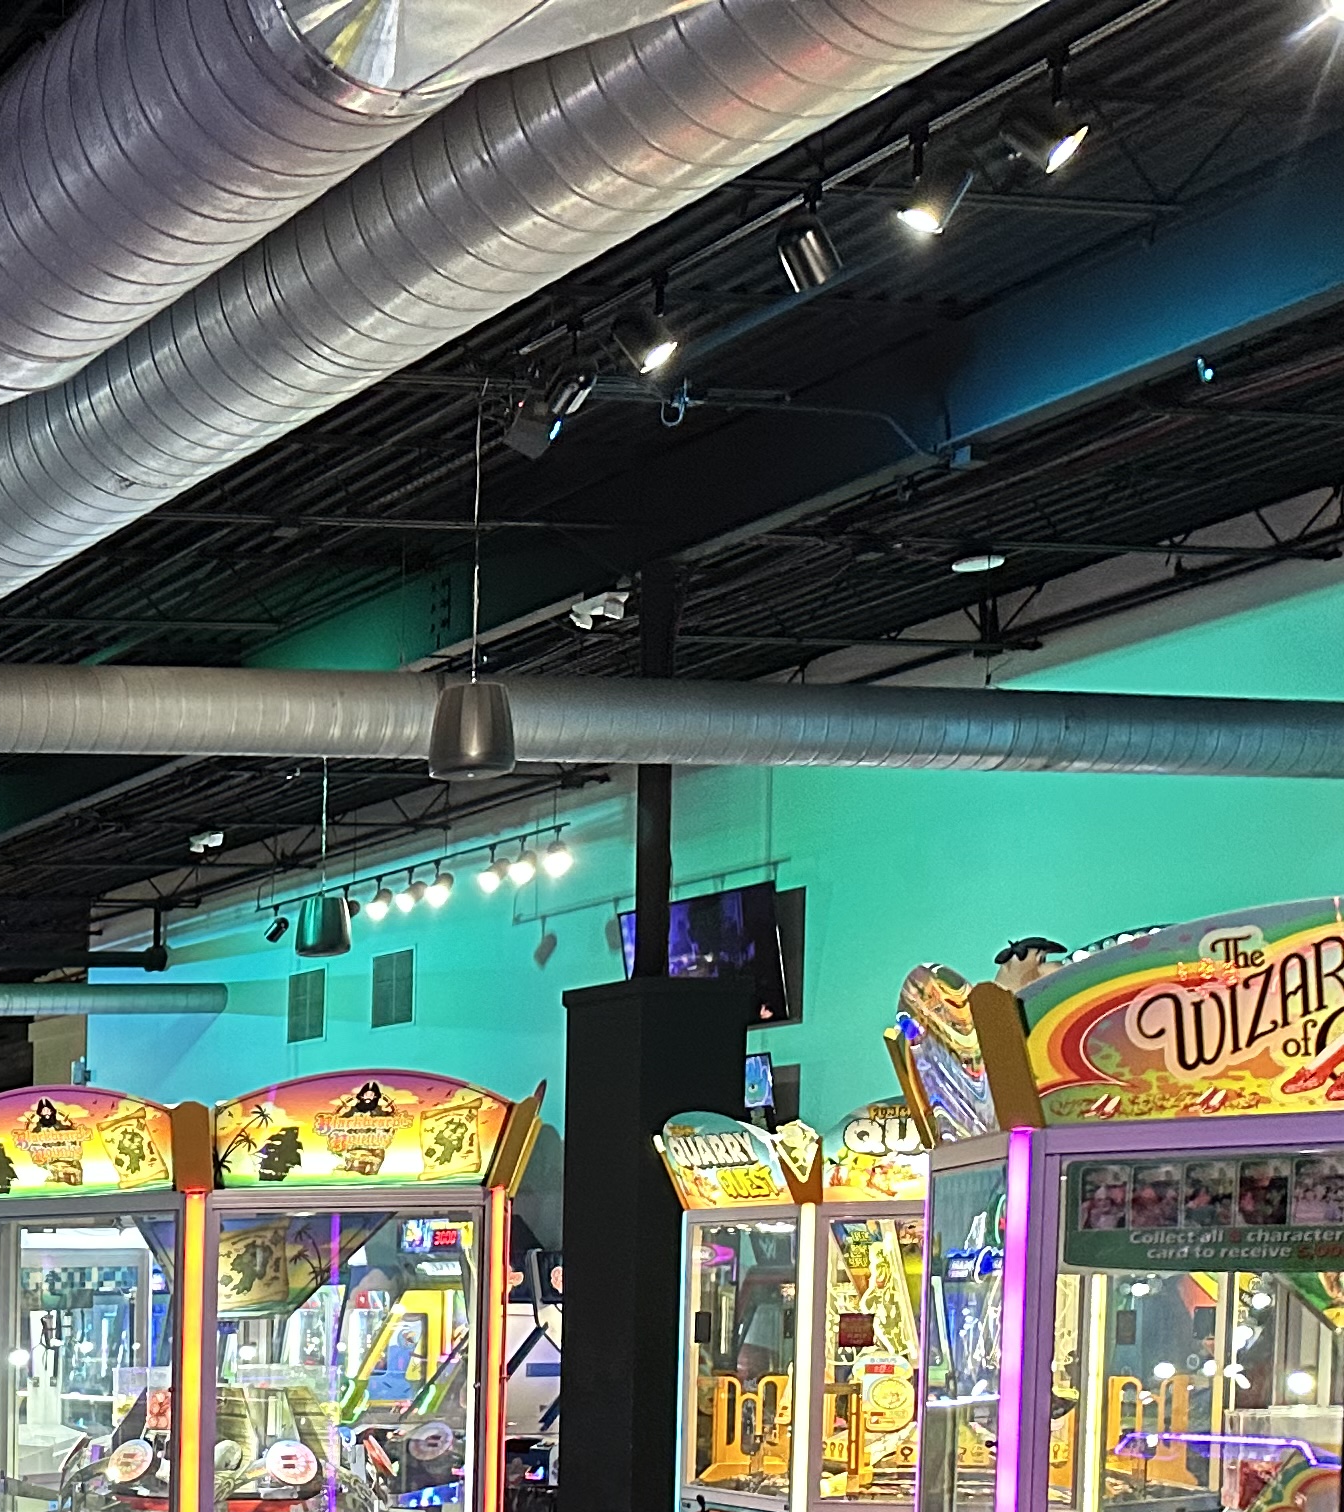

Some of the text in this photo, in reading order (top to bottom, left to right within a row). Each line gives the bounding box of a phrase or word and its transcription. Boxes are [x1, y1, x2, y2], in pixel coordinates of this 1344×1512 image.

[1210, 934, 1266, 968] The
[1282, 1018, 1318, 1058] of
[669, 1131, 760, 1168] QUARRY
[716, 1165, 779, 1198] QUEST
[1129, 1231, 1194, 1245] Collect
[1199, 1229, 1224, 1243] all
[1146, 1245, 1189, 1259] card
[1196, 1246, 1215, 1259] to
[1219, 1246, 1293, 1259] receive
